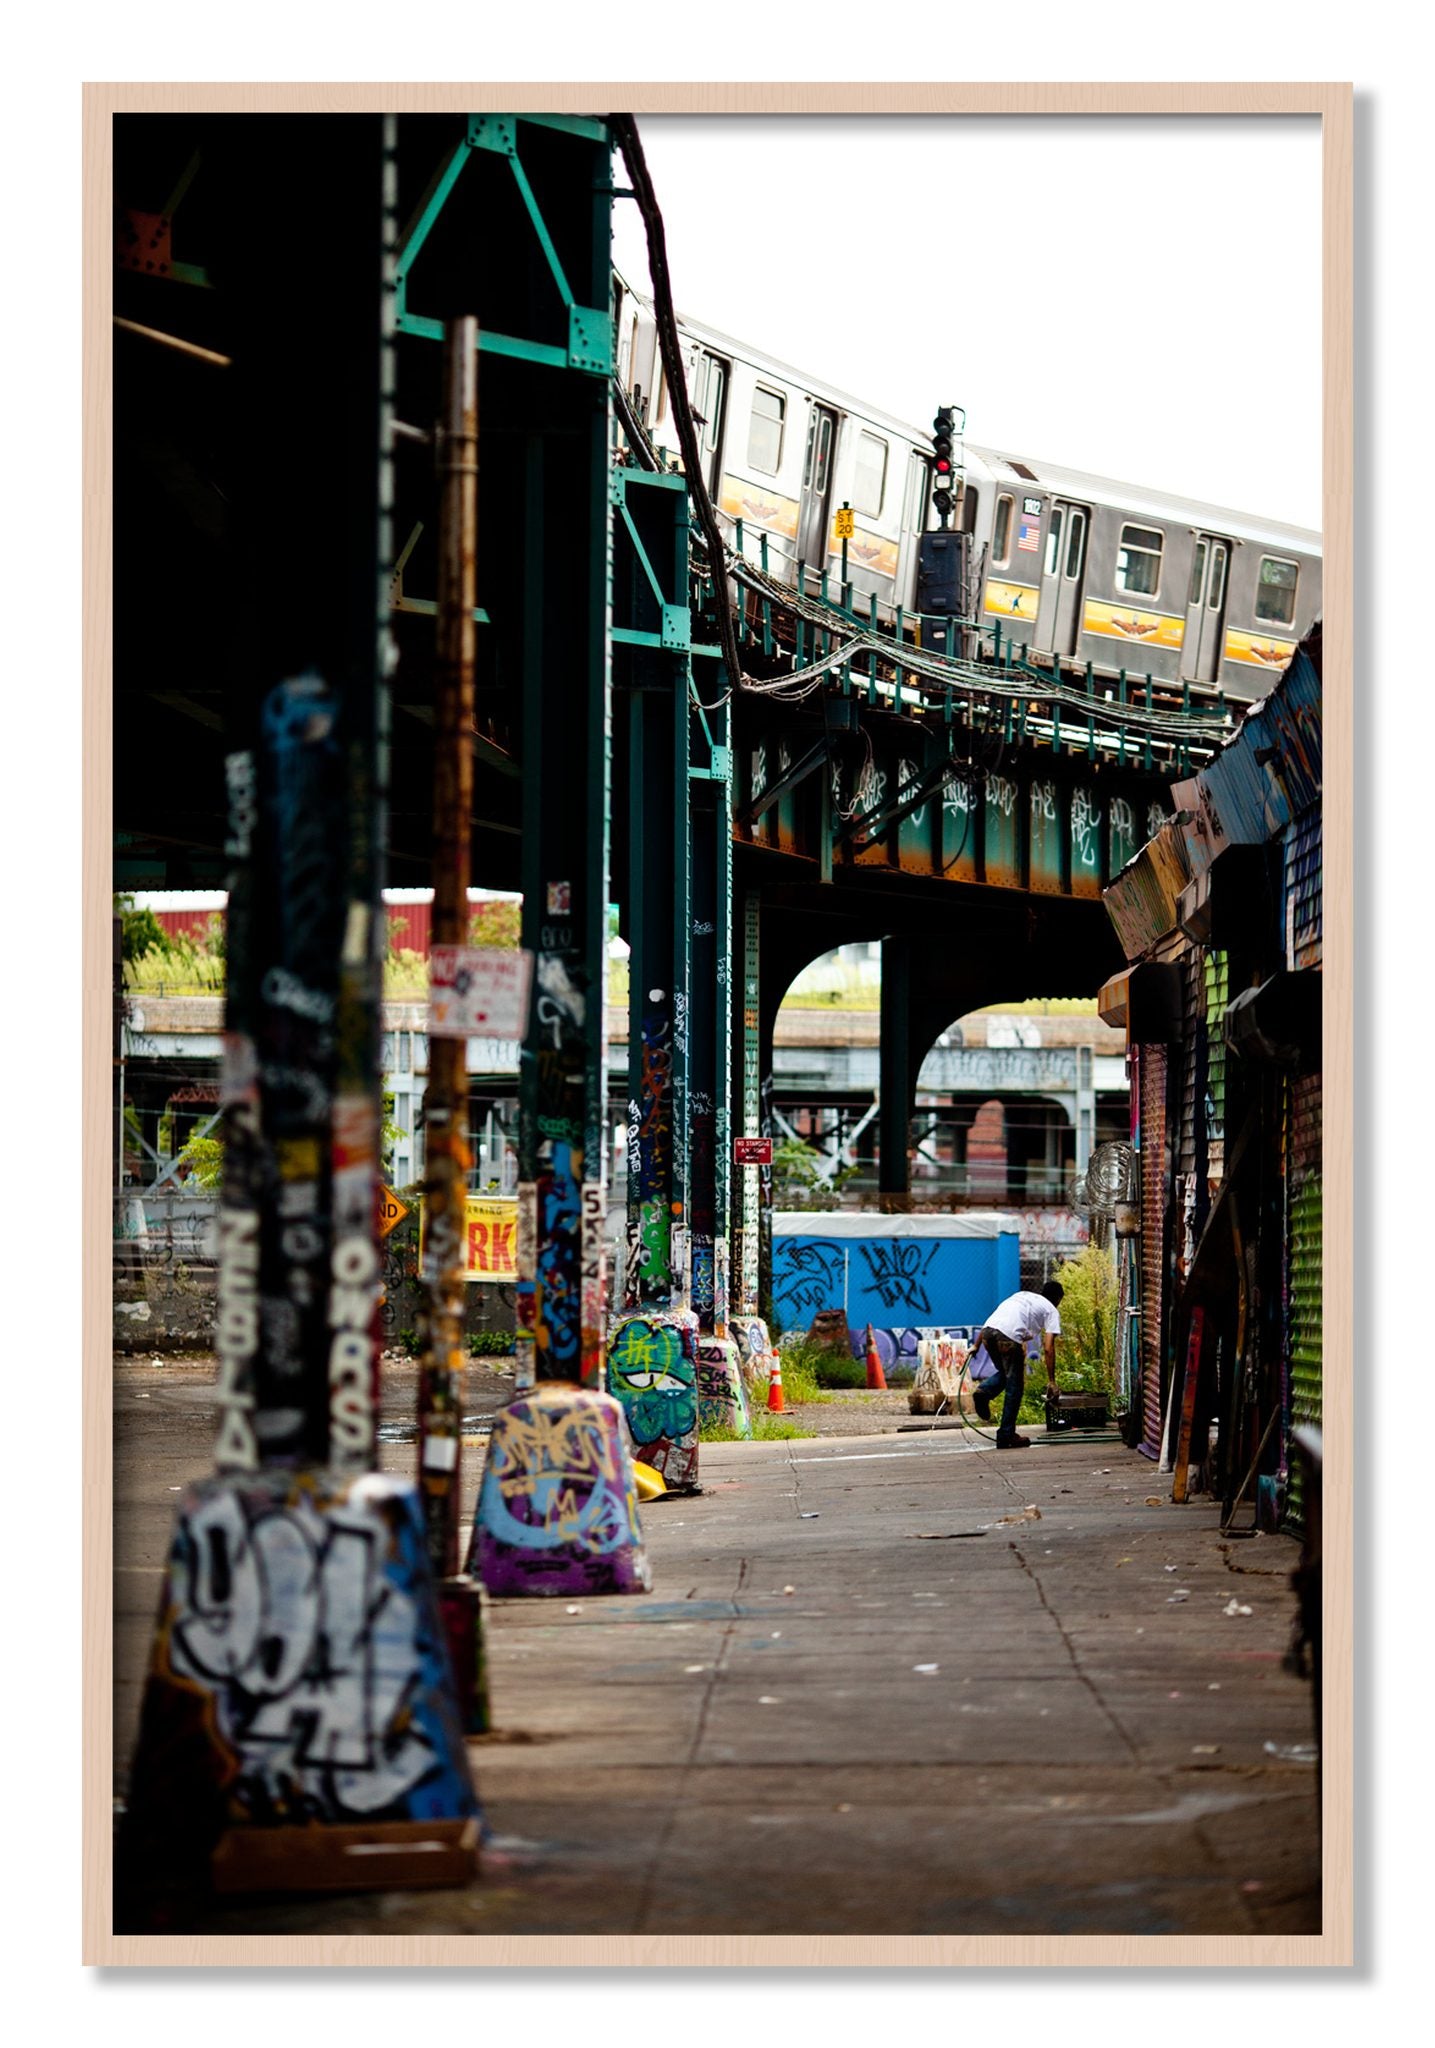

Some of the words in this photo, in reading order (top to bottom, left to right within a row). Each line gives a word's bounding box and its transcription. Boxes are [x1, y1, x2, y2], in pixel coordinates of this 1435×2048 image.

[838, 512, 851, 523] ST
[839, 525, 852, 534] 20
[466, 1206, 502, 1216] ARKING
[468, 1221, 513, 1271] RK
